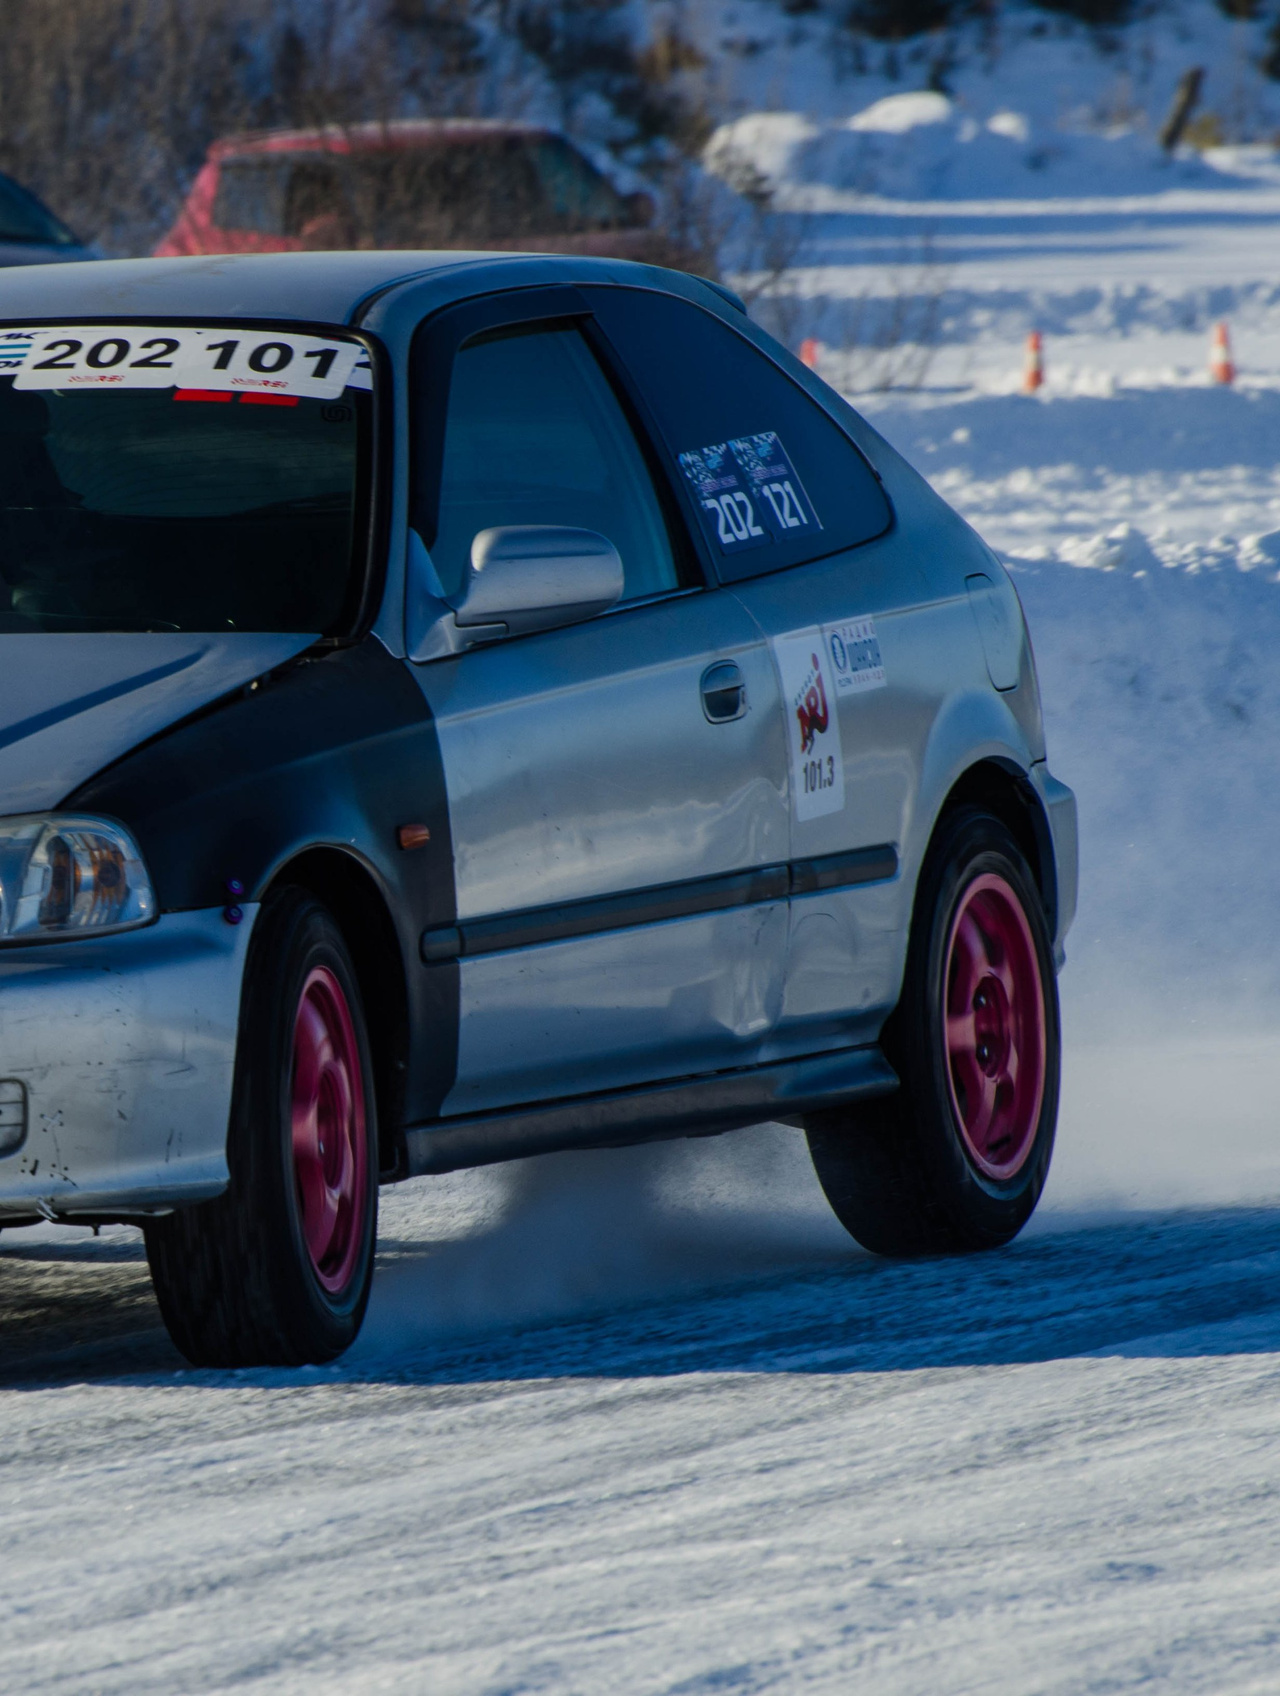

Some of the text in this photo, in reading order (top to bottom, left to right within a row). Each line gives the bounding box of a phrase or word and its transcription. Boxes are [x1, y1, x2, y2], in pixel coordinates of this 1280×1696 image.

[32, 337, 180, 370] 202
[205, 339, 340, 379] 101
[704, 491, 764, 544] 202
[761, 480, 809, 529] 121
[803, 755, 835, 794] 101.3
